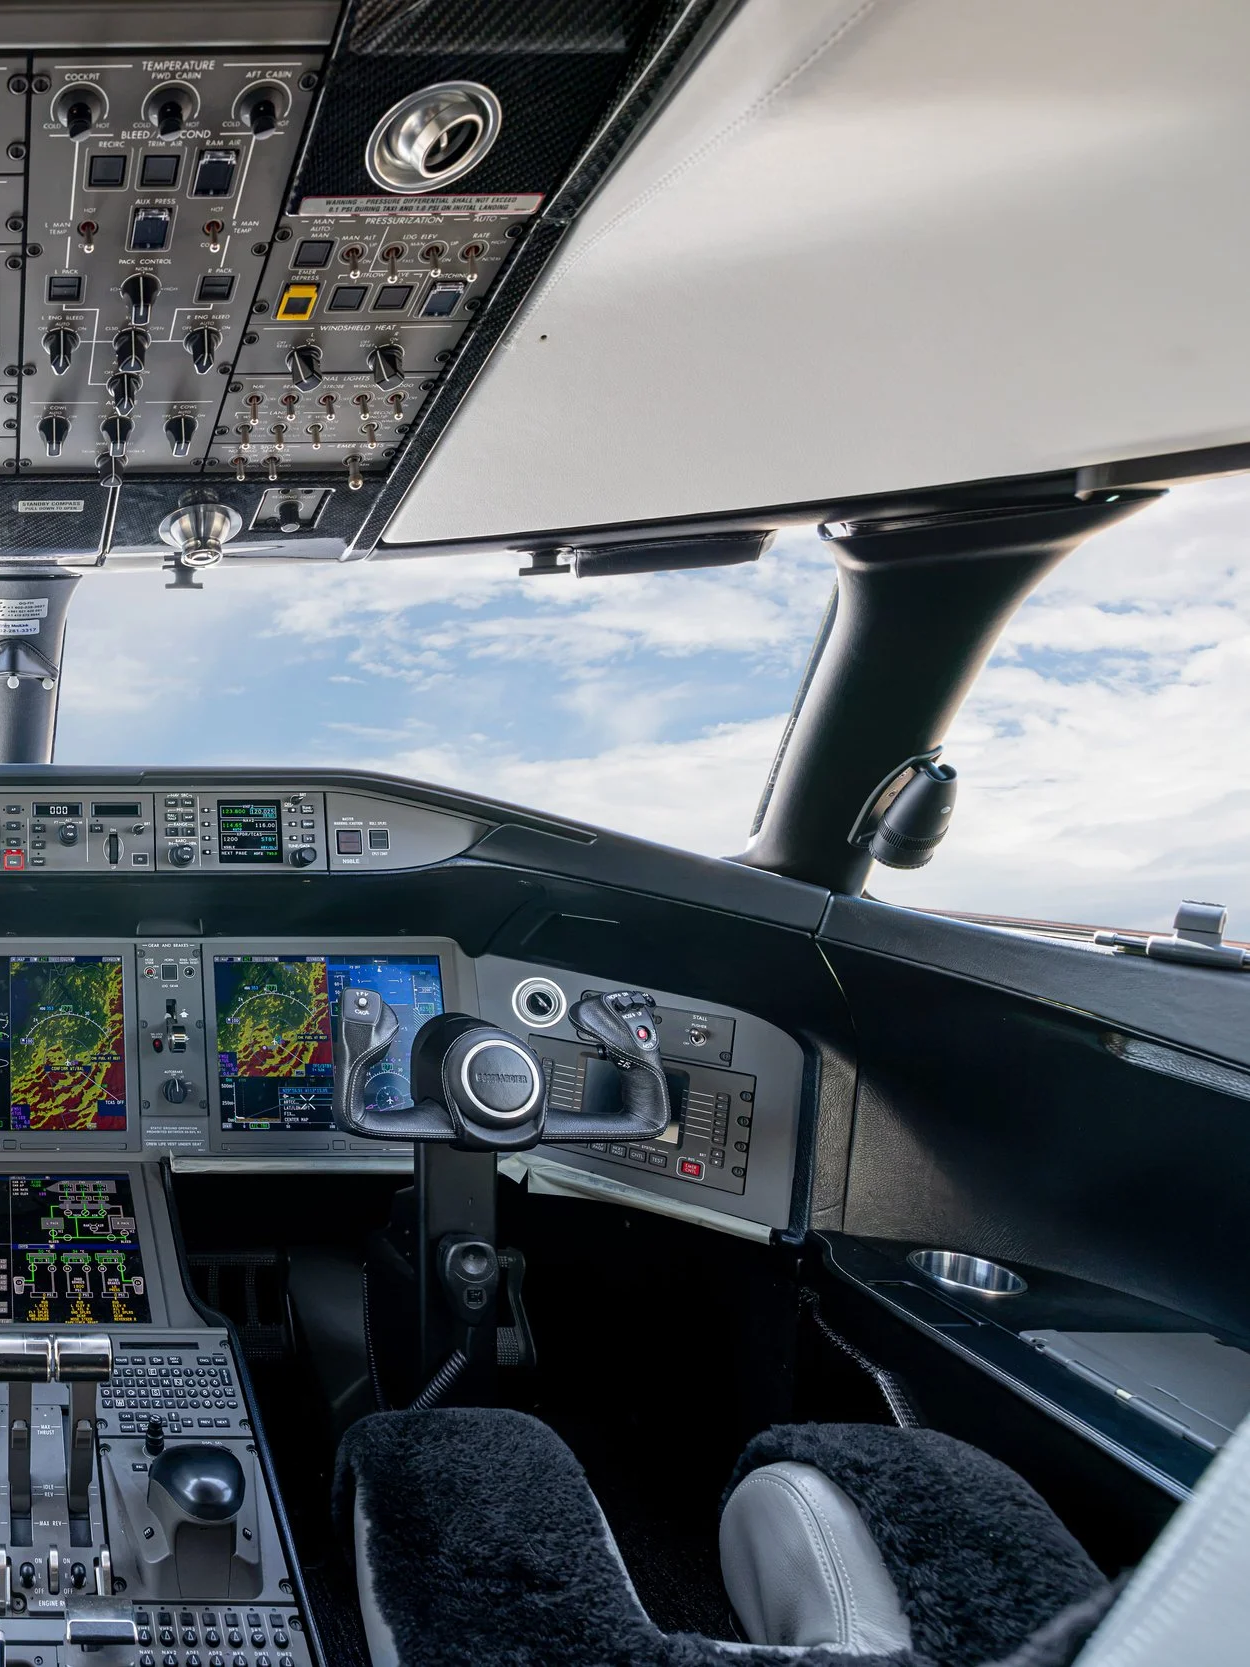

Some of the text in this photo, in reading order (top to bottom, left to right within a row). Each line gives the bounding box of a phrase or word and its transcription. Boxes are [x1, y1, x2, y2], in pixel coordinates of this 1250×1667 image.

[142, 60, 216, 71] TEMPERATURE
[65, 72, 100, 80] COCKPIT
[151, 71, 201, 79] FWD CABIN
[245, 70, 292, 79] AFT CABIN
[365, 217, 444, 225] PRESSURIZATION
[50, 806, 68, 815] 000
[631, 1152, 644, 1160] CNTL
